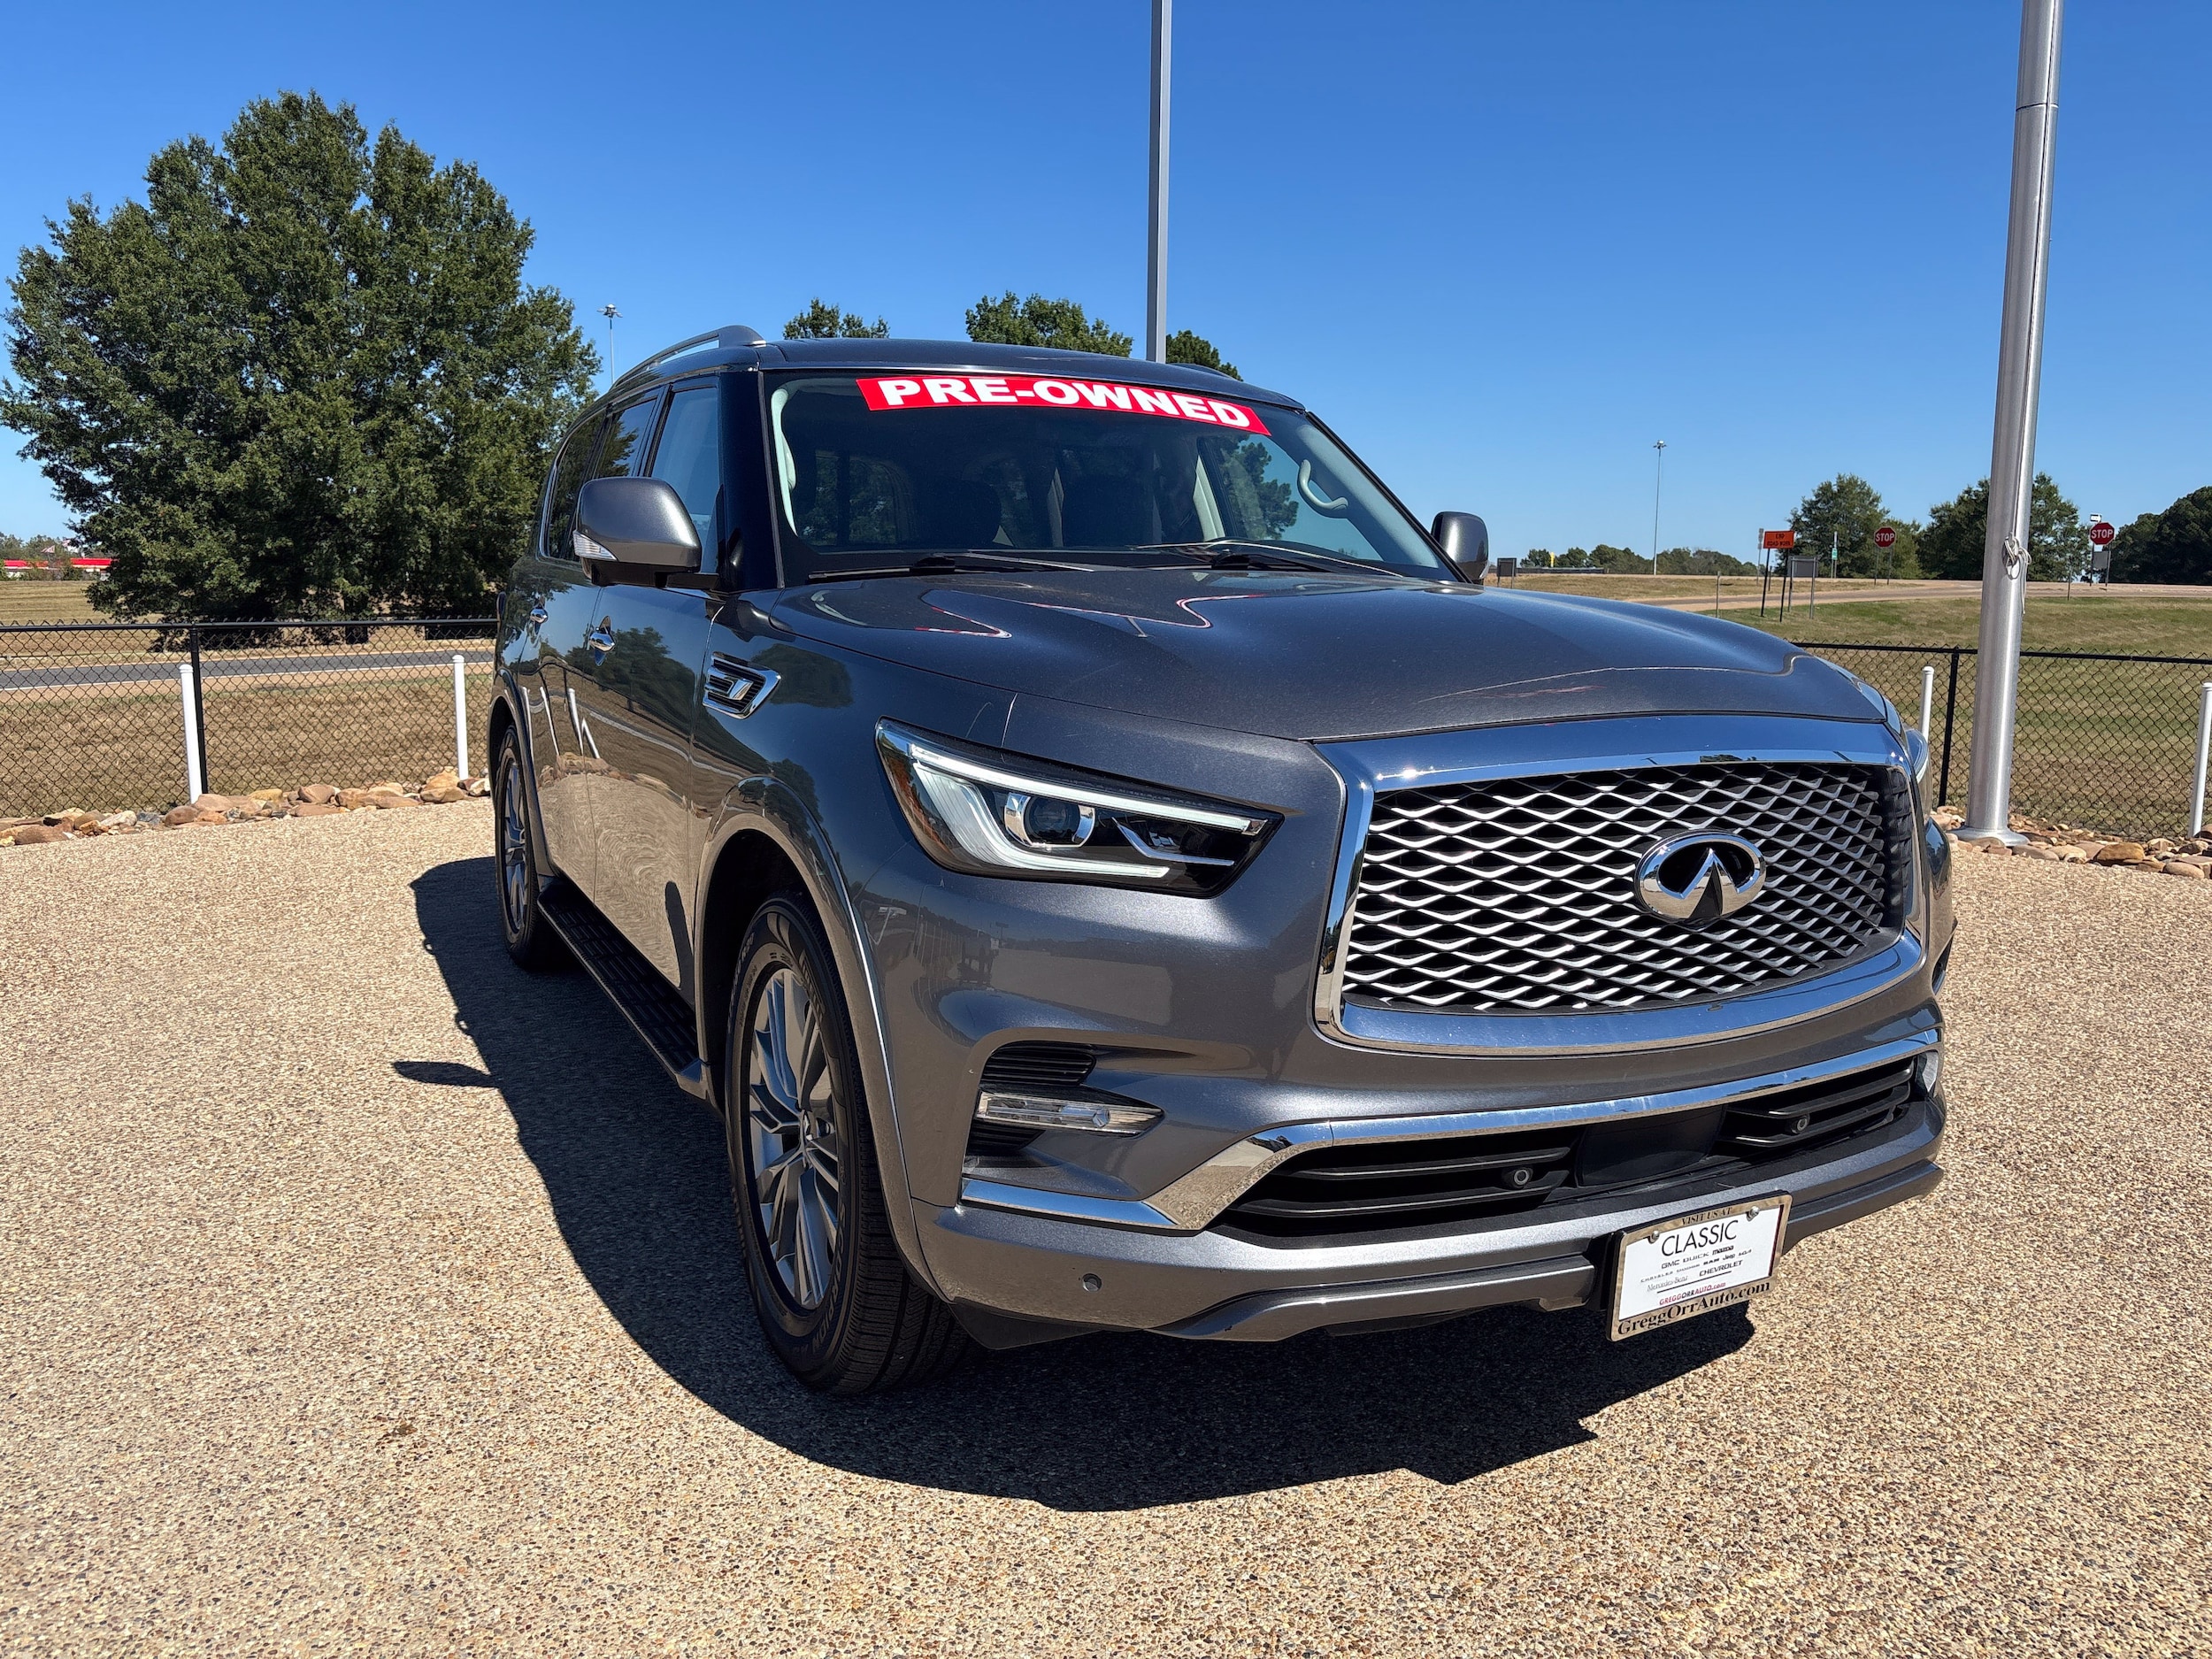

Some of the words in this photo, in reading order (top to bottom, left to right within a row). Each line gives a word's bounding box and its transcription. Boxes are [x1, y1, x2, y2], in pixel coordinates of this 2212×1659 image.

[877, 378, 1251, 428] PRE-OWNED
[1875, 533, 1894, 541] STOP
[2090, 528, 2113, 539] STOP
[1681, 1212, 1705, 1226] VISIT
[1706, 1210, 1718, 1220] US
[1719, 1207, 1732, 1216] AT
[1662, 1220, 1739, 1256] CLASSIC
[1661, 1259, 1680, 1270] GMC
[1683, 1251, 1709, 1263] BUICK
[1699, 1259, 1743, 1277] CHEVROLET
[1659, 1282, 1726, 1306] GREGGORRAUTO.com
[1617, 1282, 1770, 1335] GreggOrrAuto.com
